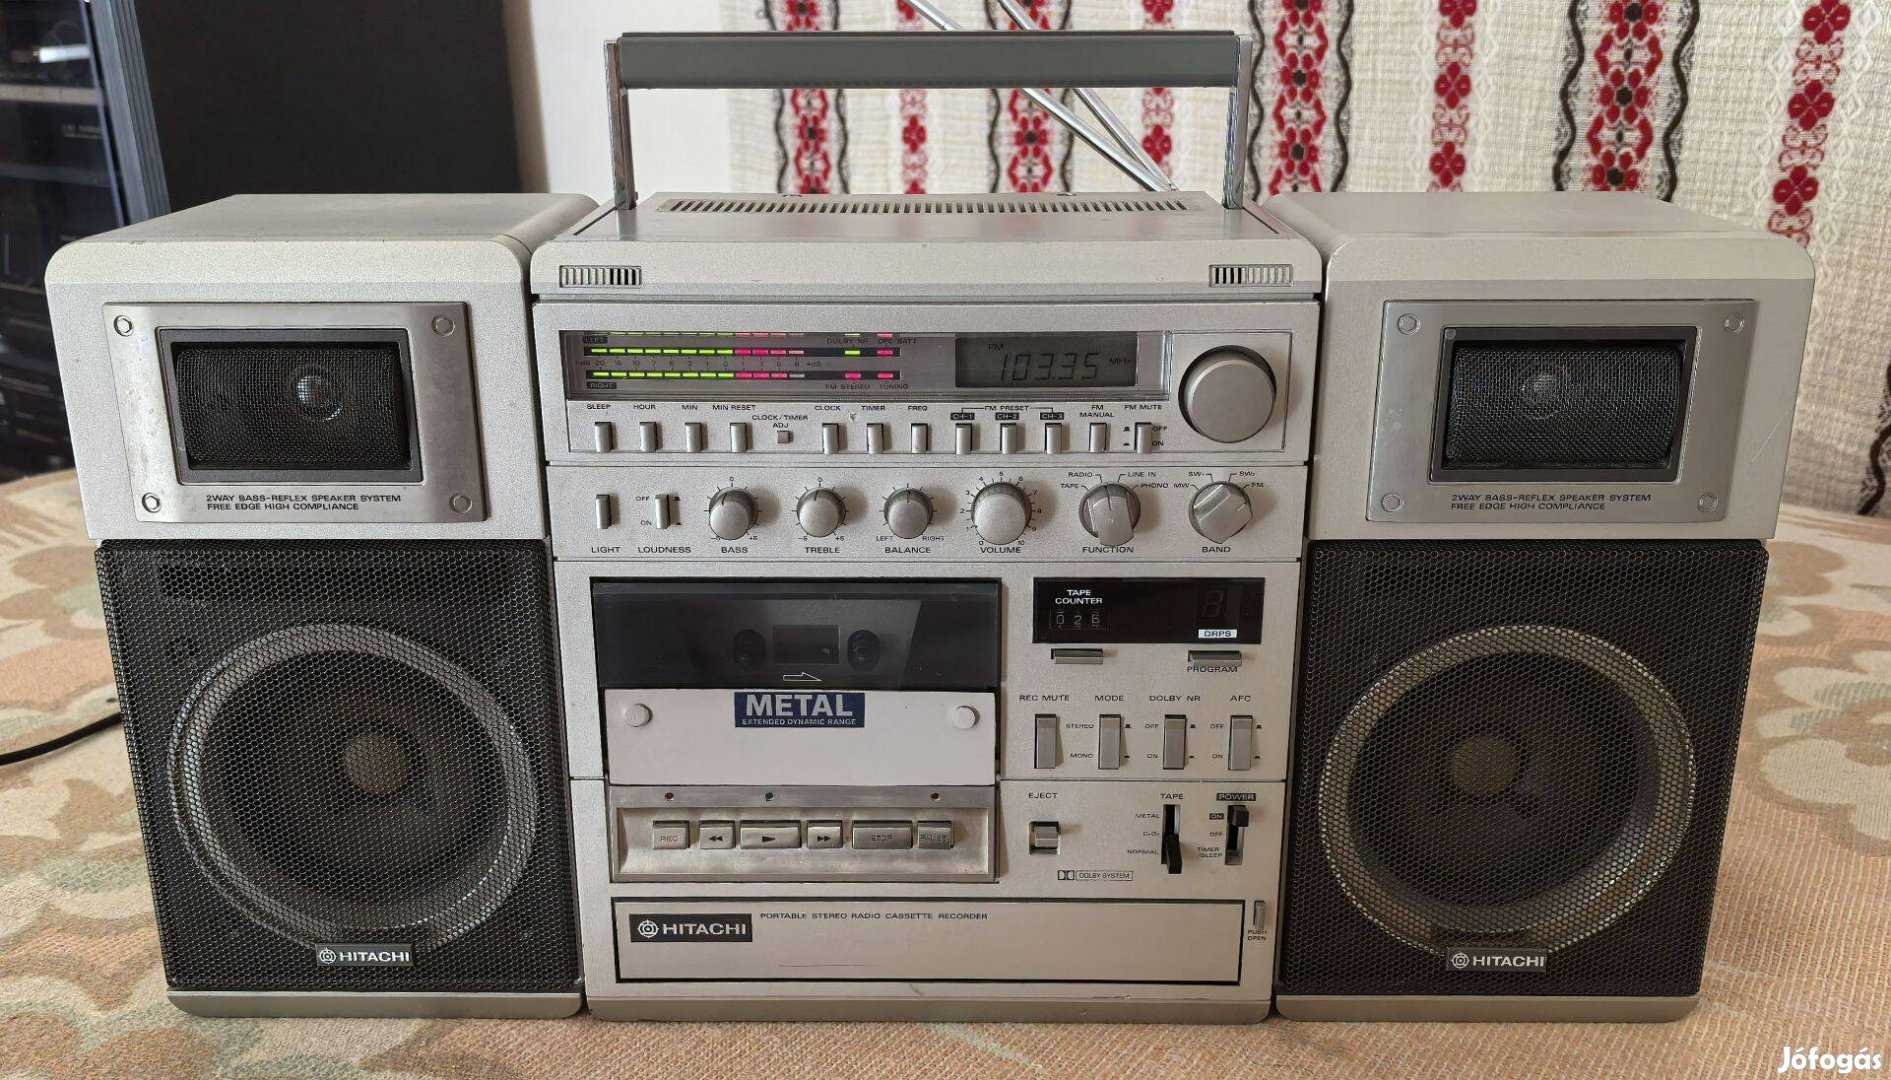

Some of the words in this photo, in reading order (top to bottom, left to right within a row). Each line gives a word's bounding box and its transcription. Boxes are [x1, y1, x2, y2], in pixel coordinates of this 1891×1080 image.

[206, 494, 235, 502] 2WAY
[238, 494, 308, 502] BASS-REFLEX
[311, 494, 357, 502] SPEAKER
[360, 494, 402, 502] SYSTEM
[1452, 494, 1481, 502] 2WAY
[1485, 494, 1555, 502] BASS-REFLEX
[1560, 494, 1605, 502] SPEAKER
[1609, 494, 1652, 502] SYSTEM
[207, 503, 232, 511] FREE
[235, 503, 262, 511] EDGE
[265, 503, 290, 511] HIGH
[293, 503, 360, 511] COMPLIANCE
[1451, 503, 1475, 511] FREE
[1479, 503, 1506, 511] EDGE
[1509, 503, 1536, 511] HIGH
[1538, 503, 1606, 511] COMPLIANCE
[591, 546, 621, 554] LIGHT
[638, 546, 692, 554] LOUDNESS
[1055, 597, 1103, 605] COUNTER
[746, 694, 853, 717] METAL
[1218, 793, 1255, 801] POWER
[663, 923, 747, 935] HITACHI
[340, 951, 410, 962] HITACHI
[1472, 956, 1545, 967] HITACHI
